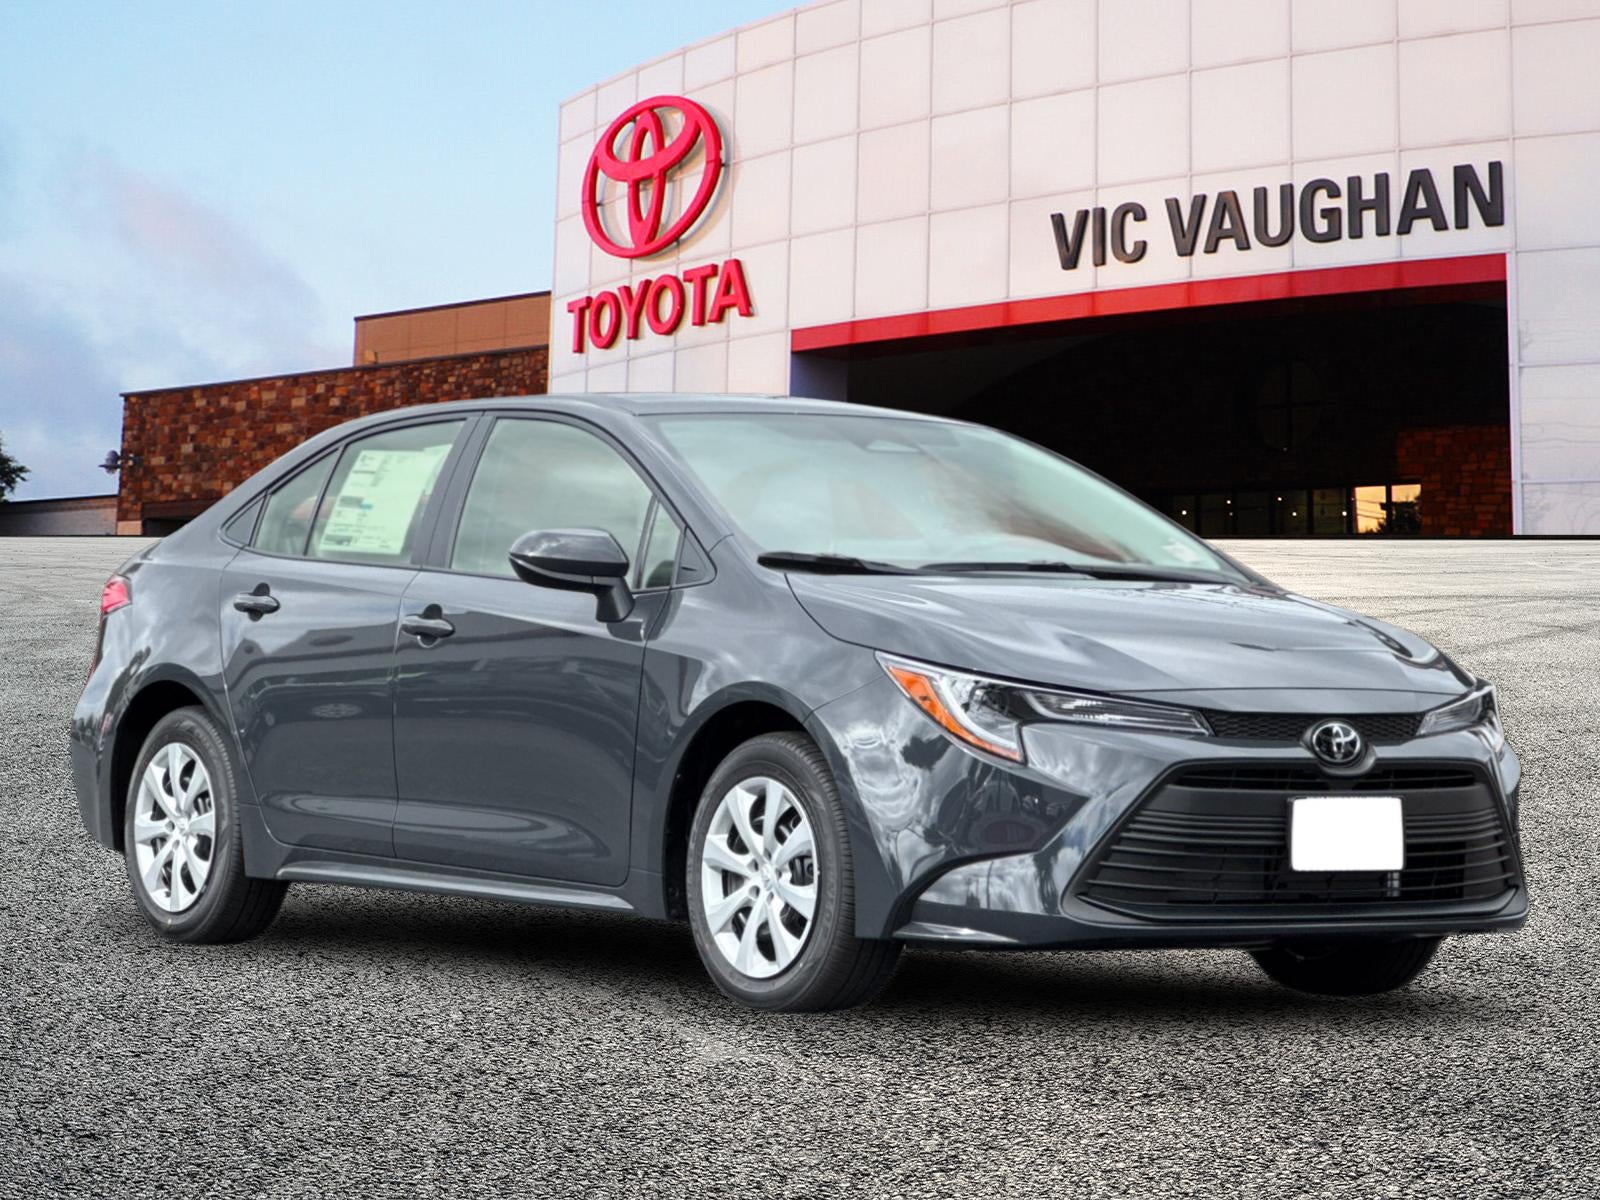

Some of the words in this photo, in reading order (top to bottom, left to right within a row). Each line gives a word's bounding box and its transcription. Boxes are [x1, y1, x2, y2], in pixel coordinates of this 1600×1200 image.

[1051, 202, 1147, 270] VIC
[1165, 161, 1504, 256] VAUGHAN
[567, 259, 754, 353] TOYOTA
